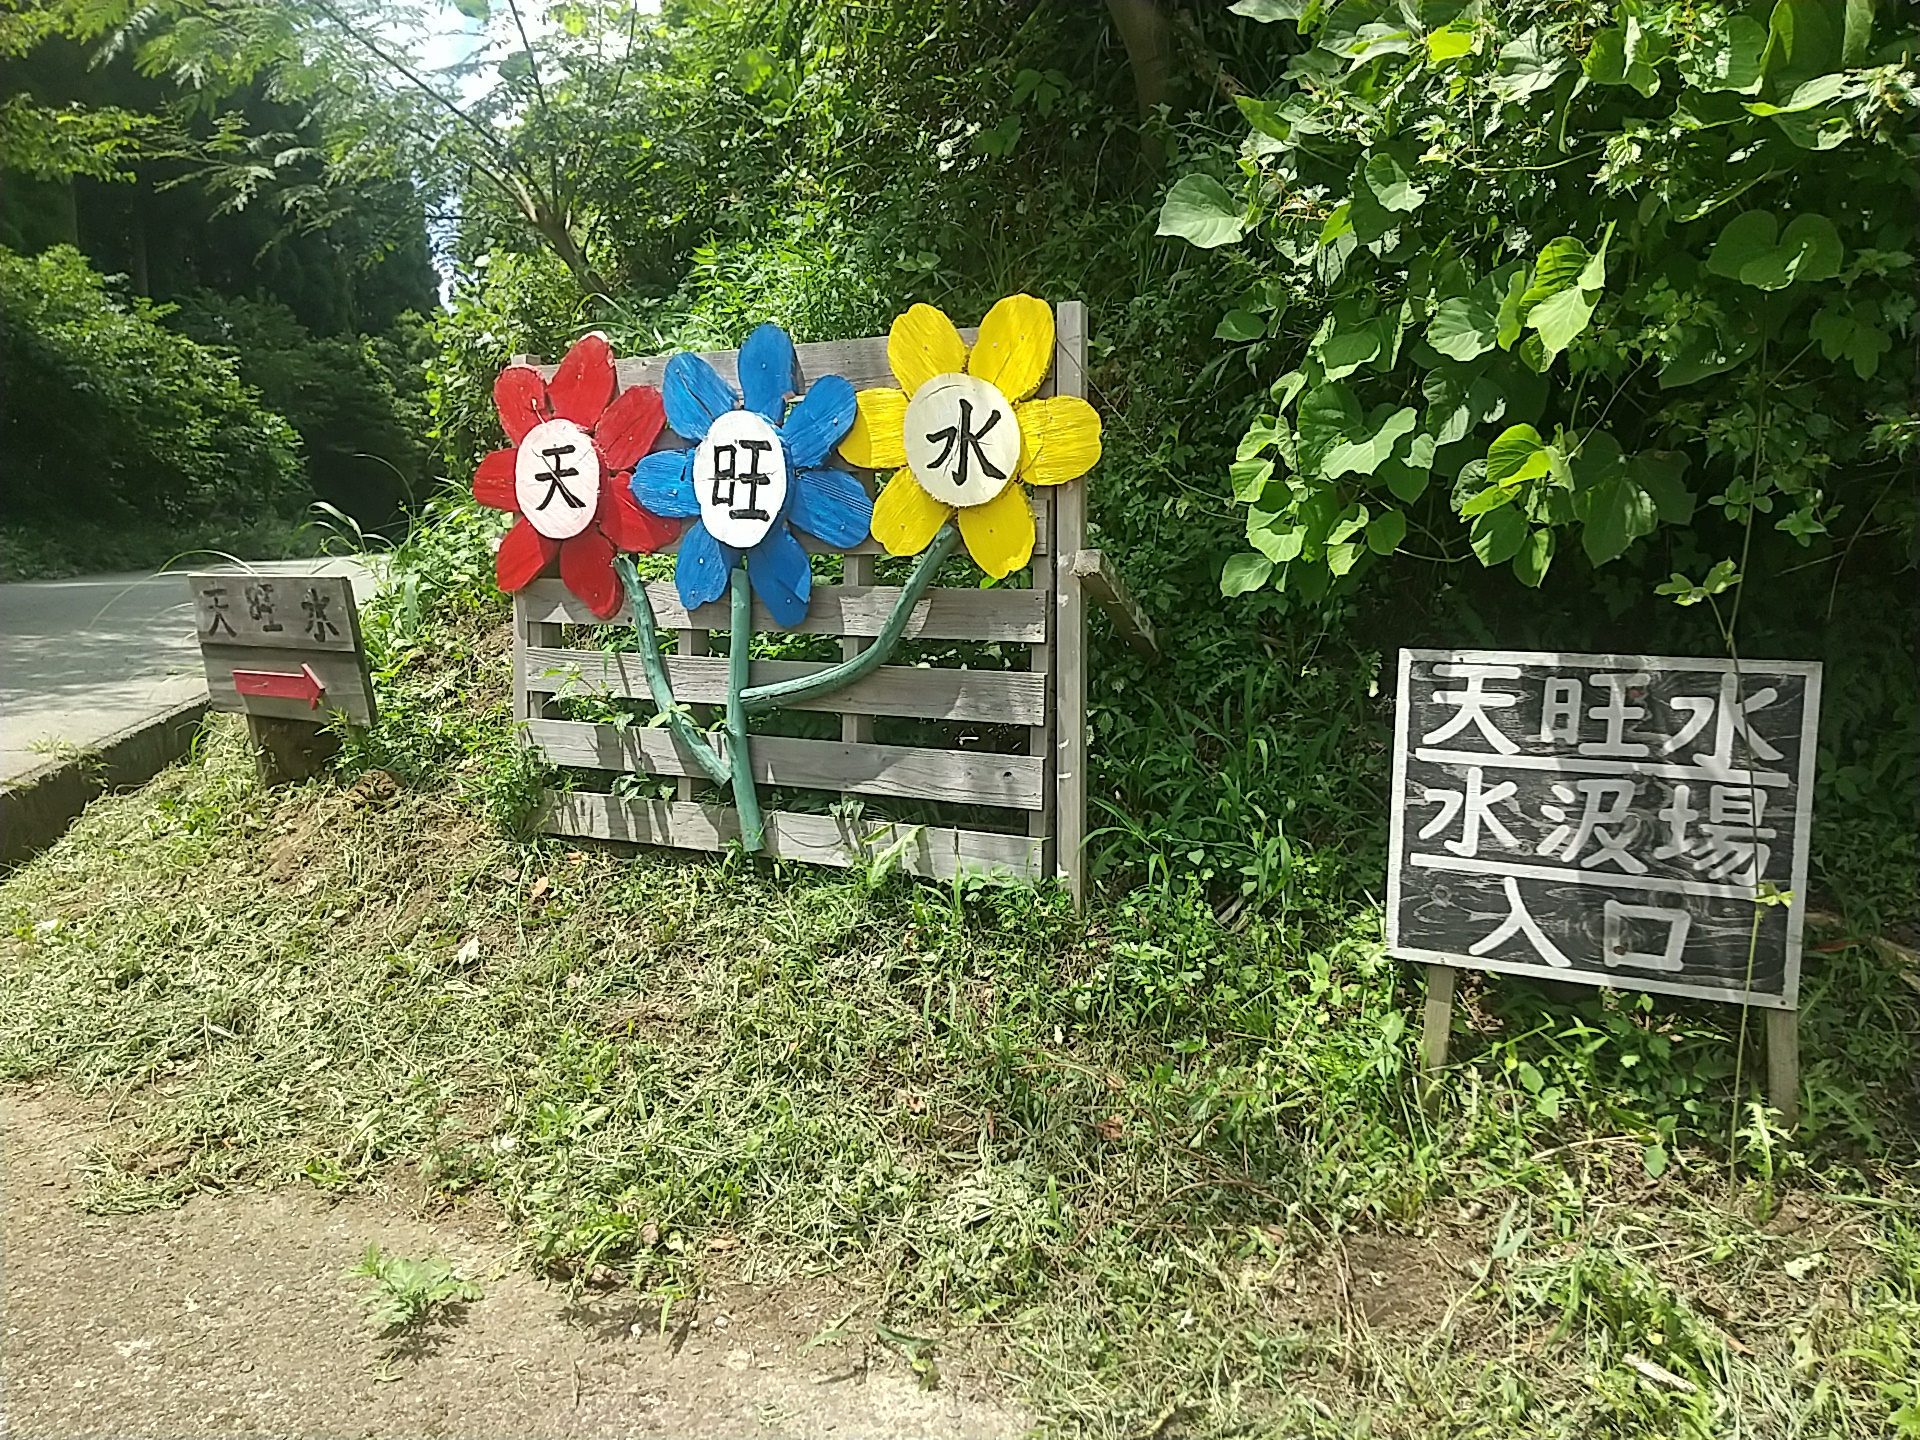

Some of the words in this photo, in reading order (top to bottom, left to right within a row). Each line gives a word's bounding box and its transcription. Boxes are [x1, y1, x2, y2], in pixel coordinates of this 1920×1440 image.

[534, 444, 586, 510] 天
[710, 439, 773, 522] 旺
[925, 398, 1008, 486] 水
[203, 583, 340, 643] 天旺水
[1422, 663, 1785, 770] 天旺水
[1418, 766, 1778, 887] 水汲場
[1468, 876, 1692, 972] 入口
